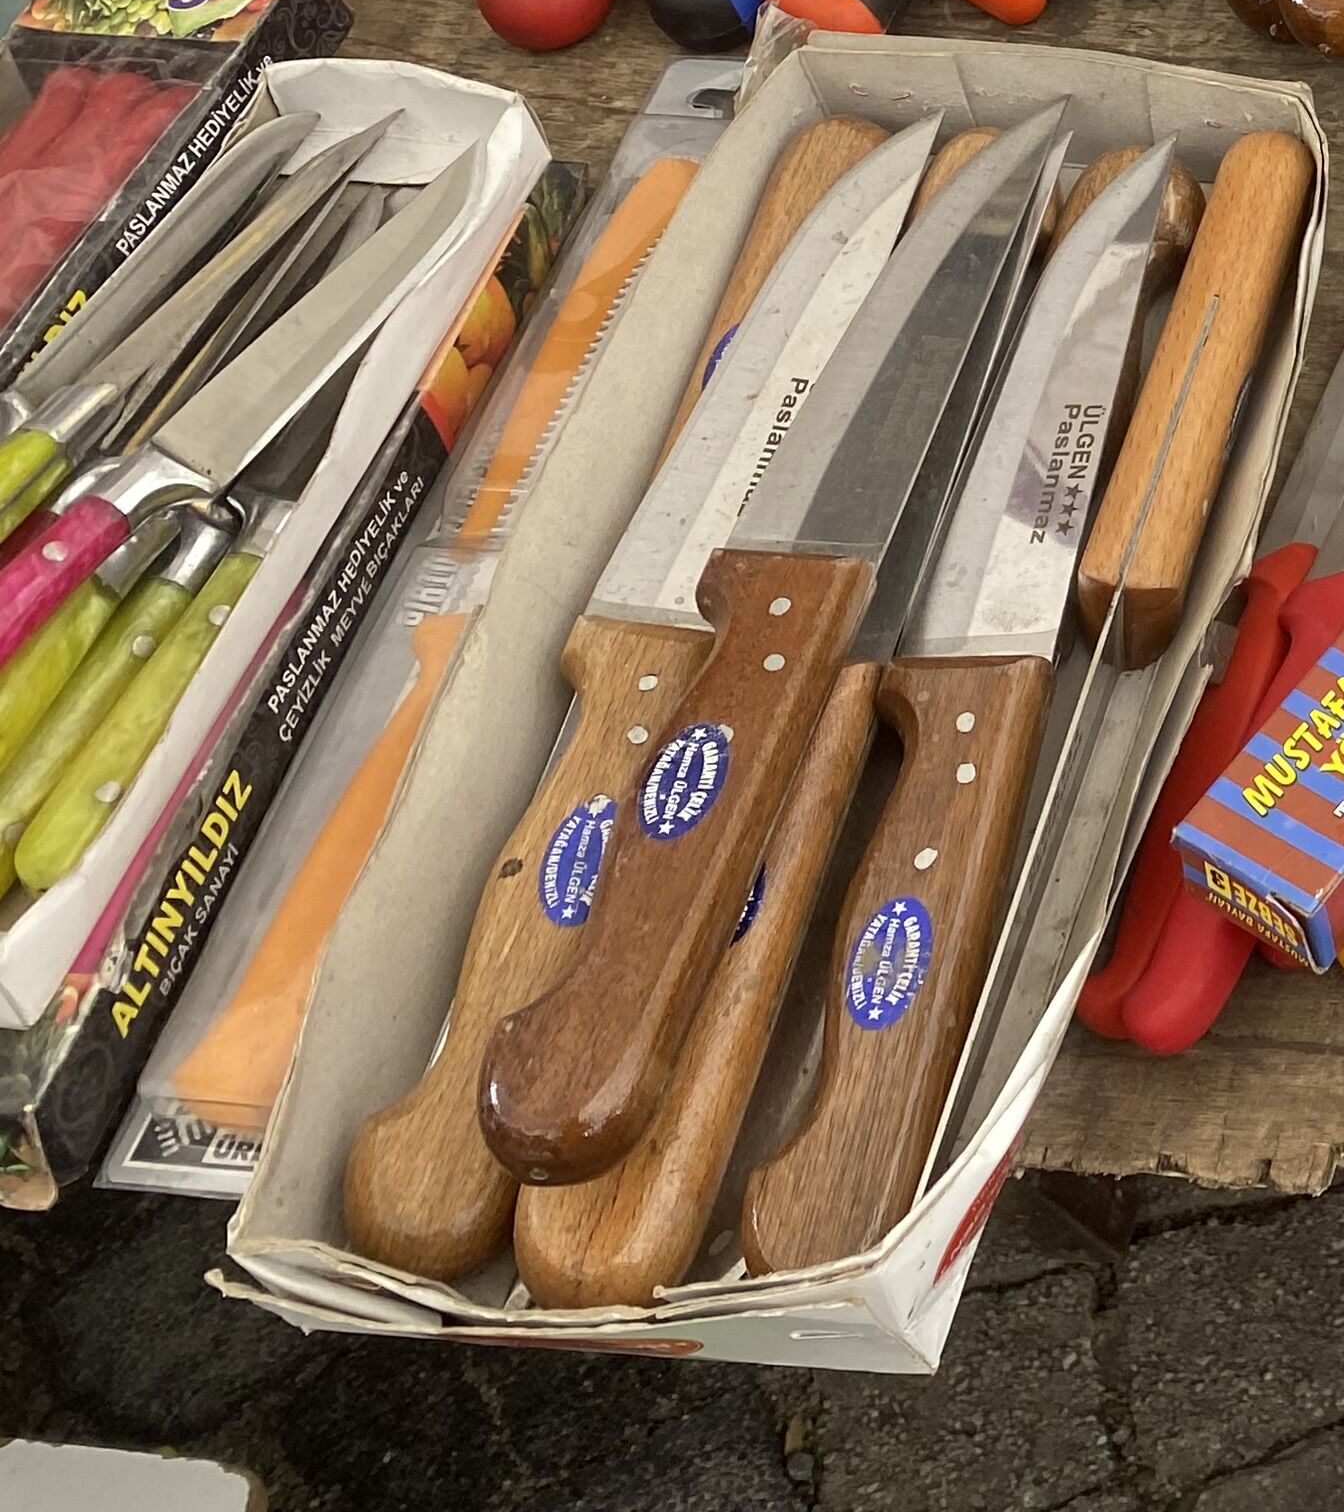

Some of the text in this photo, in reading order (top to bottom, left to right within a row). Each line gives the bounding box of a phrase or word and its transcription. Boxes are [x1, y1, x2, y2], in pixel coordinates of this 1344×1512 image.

[115, 153, 197, 258] PASLANMAZ
[1028, 403, 1082, 545] Paslanmaz
[1067, 404, 1107, 481] ÜLGEN
[266, 468, 411, 715] PASLANMAZ HEDİYELİK ve
[278, 476, 426, 744] ÇEYİZLİK MEYVE BIÇAKLARI
[109, 768, 253, 1040] ALTINYILDIZ
[157, 844, 240, 998] BIÇAK SANAYİ
